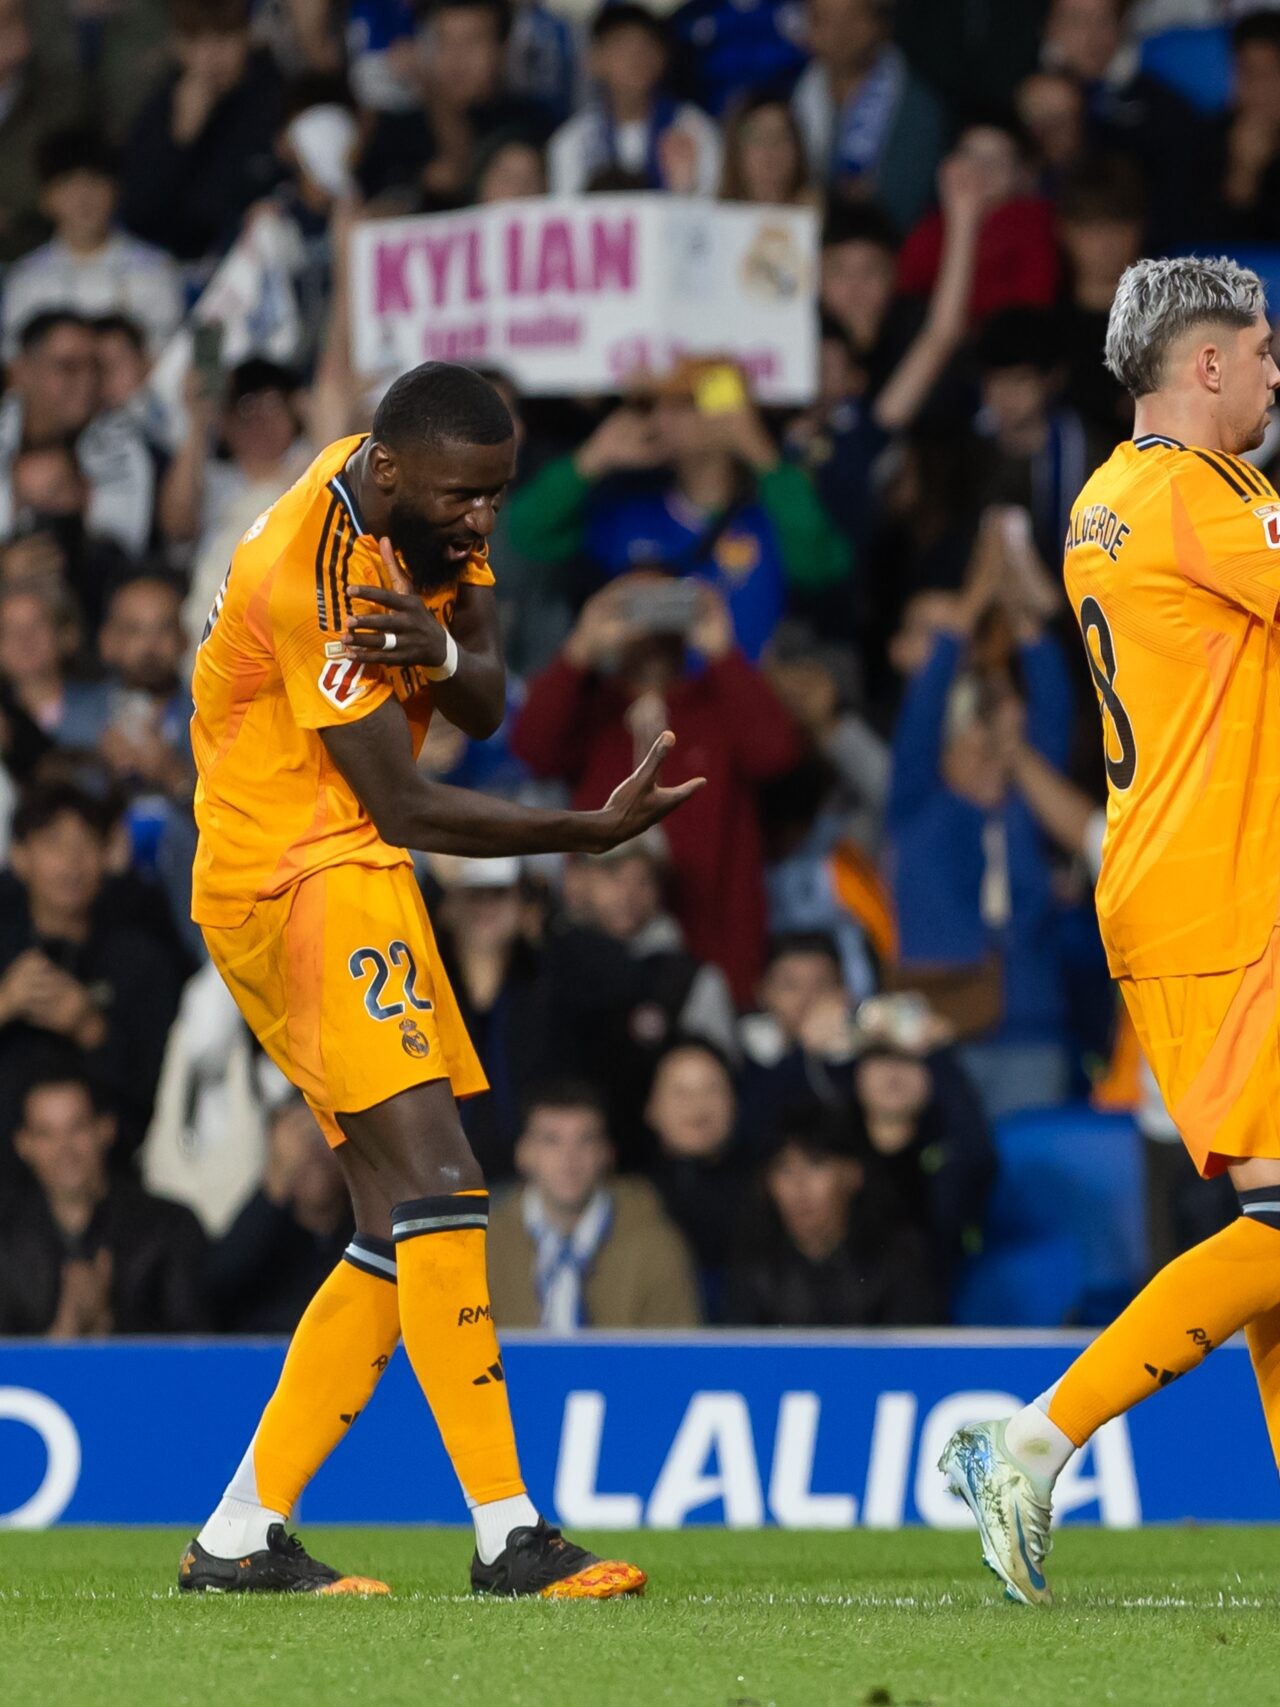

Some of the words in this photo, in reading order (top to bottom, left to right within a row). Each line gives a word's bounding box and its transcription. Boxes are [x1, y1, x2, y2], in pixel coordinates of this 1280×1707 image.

[373, 215, 636, 317] KYLIAN
[1065, 504, 1131, 563] ALVERDE
[1080, 595, 1137, 792] 8
[348, 939, 434, 1022] 22
